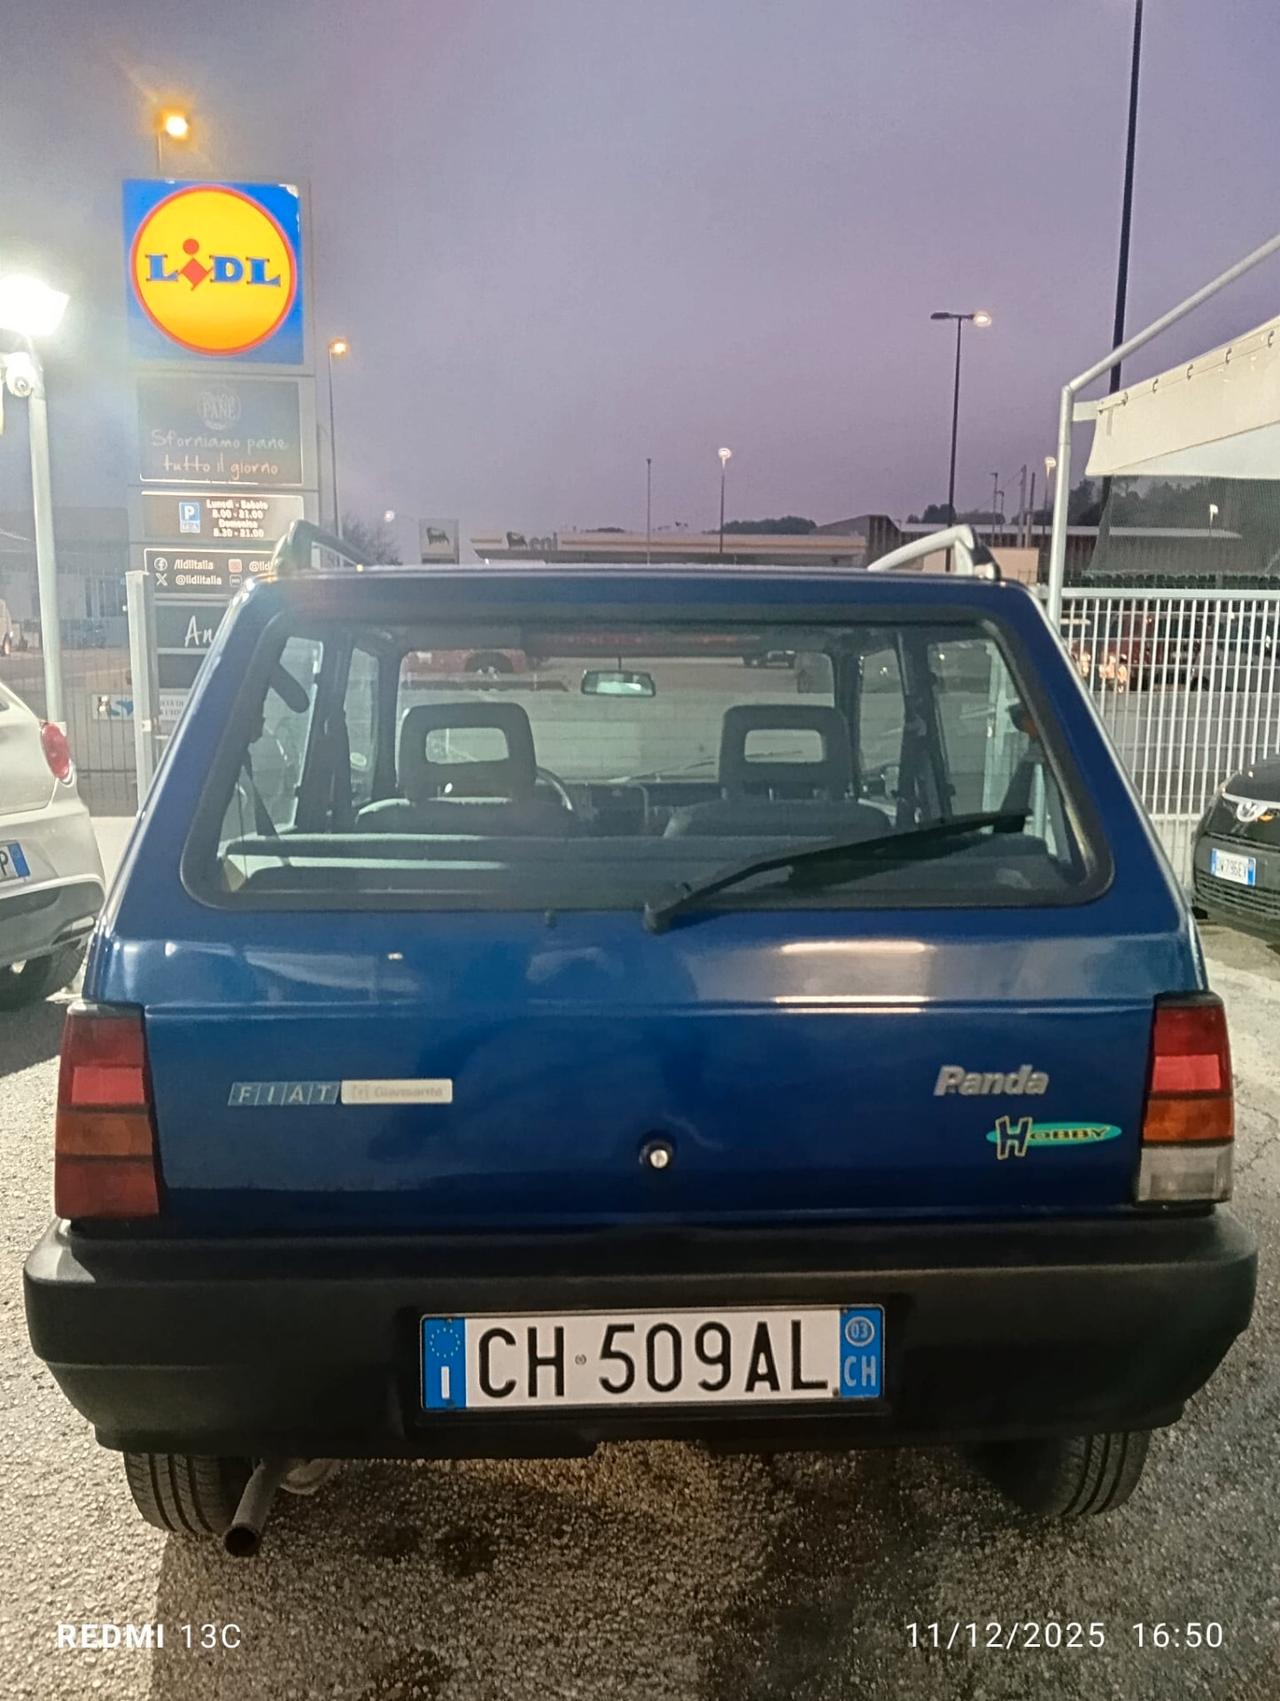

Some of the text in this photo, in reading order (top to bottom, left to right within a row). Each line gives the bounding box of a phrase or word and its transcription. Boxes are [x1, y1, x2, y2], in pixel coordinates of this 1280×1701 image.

[151, 429, 288, 455] Sforniamo pane
[163, 453, 279, 481] tutto il giorno
[239, 509, 263, 519] 21.00
[240, 528, 264, 538] 21.00
[175, 574, 222, 585] @lidlitalia
[184, 615, 213, 648] An
[933, 1063, 1050, 1096] Panda
[238, 1084, 332, 1103] FIAT
[850, 1321, 869, 1340] 03
[478, 1326, 565, 1398] CH
[599, 1319, 829, 1395] 509AL
[843, 1354, 877, 1387] CH
